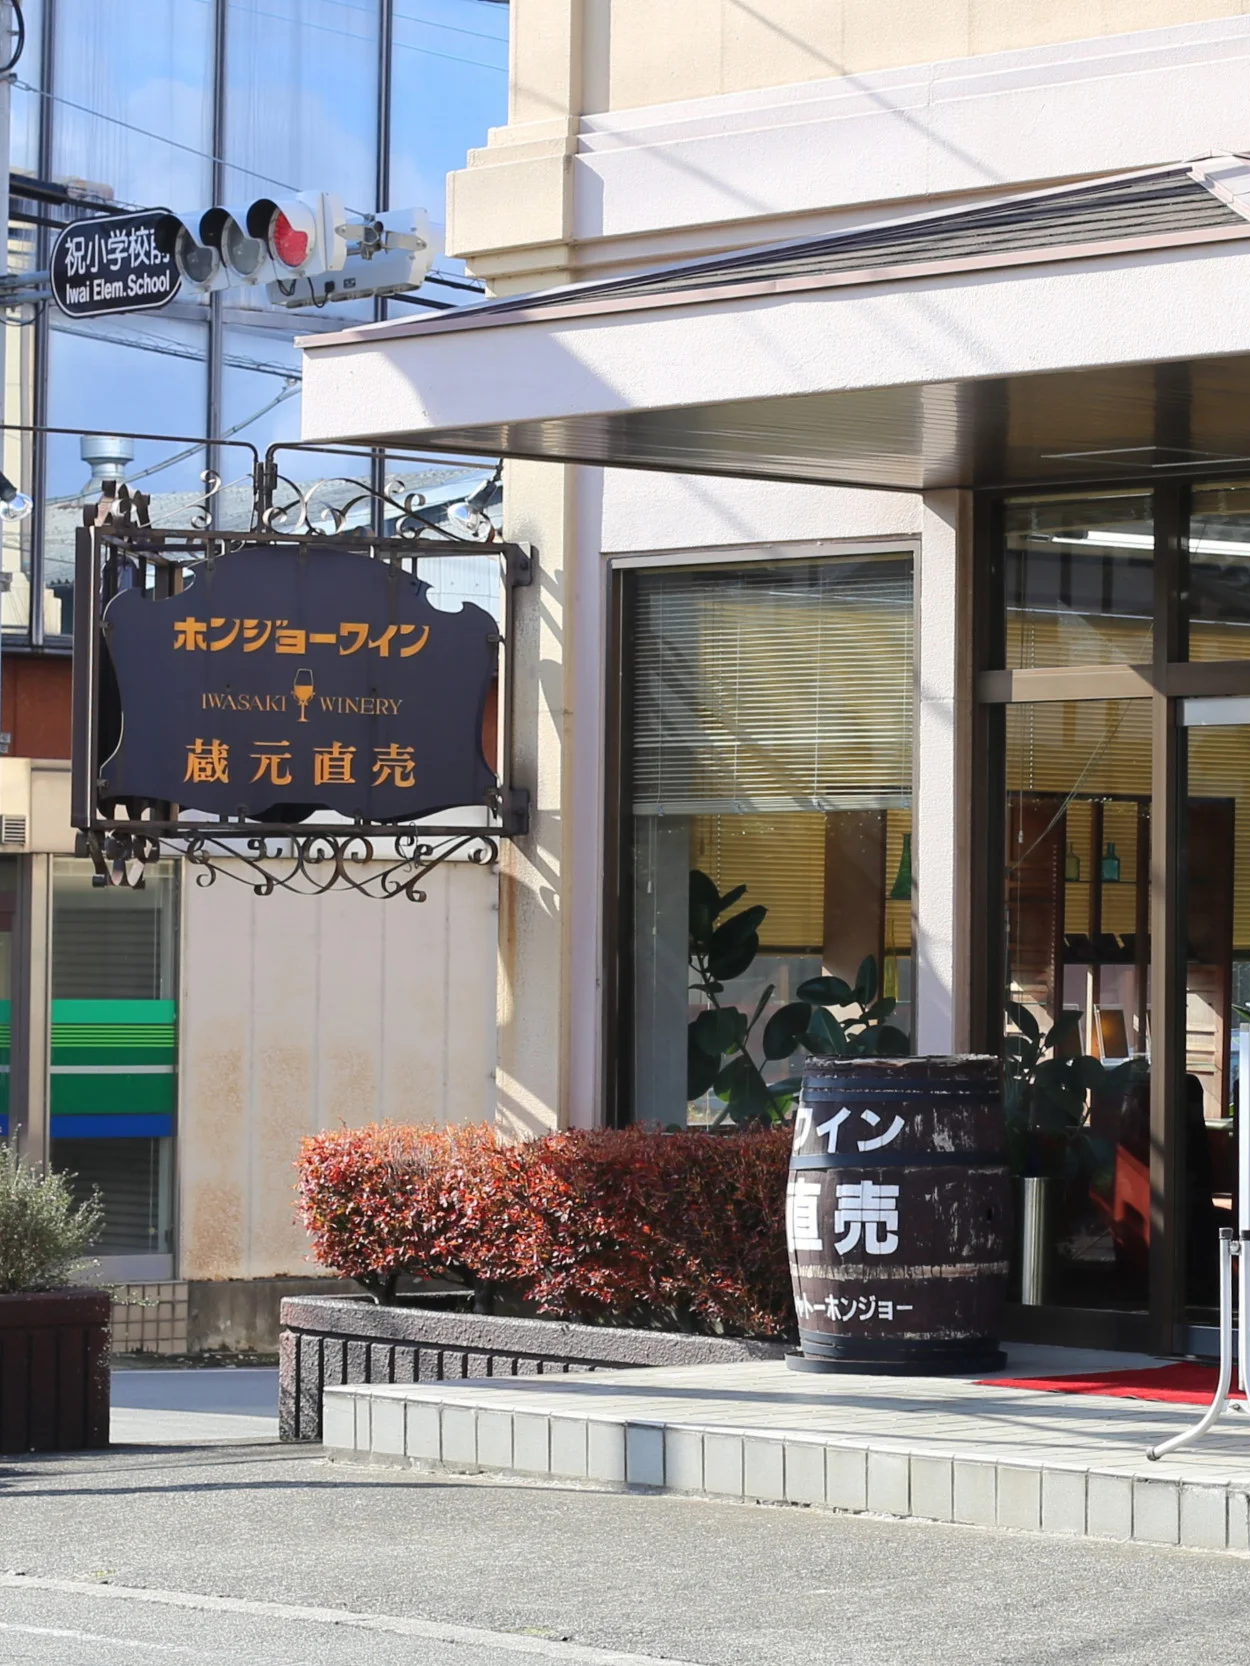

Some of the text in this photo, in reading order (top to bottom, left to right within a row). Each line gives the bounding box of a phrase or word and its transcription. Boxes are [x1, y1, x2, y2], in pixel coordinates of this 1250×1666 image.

[66, 281, 90, 305] Iwai
[173, 617, 430, 657] ホンジョーワイン
[202, 693, 403, 716] IWASAKI WINERY
[183, 738, 416, 788] 蔵元直売
[786, 1177, 899, 1256] 直売
